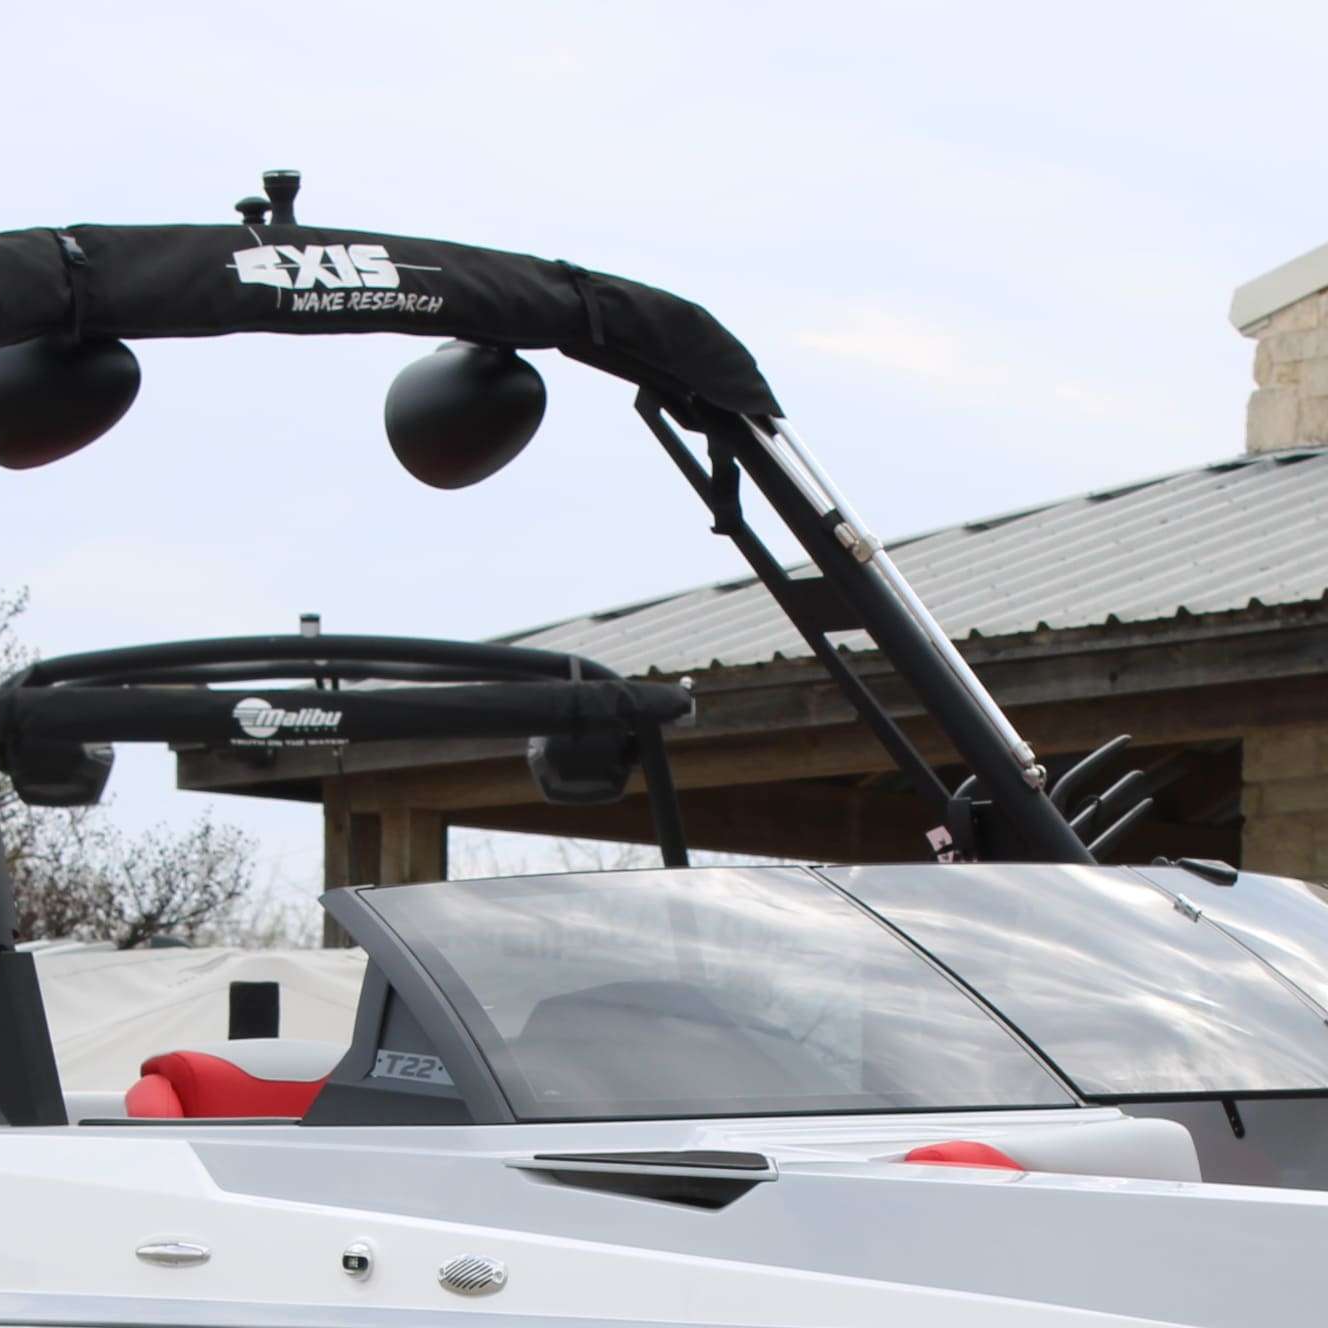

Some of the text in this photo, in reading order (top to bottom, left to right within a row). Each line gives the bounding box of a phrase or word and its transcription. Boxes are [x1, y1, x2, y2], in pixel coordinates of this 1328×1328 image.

[231, 243, 401, 290] AXIS
[290, 291, 444, 314] WAKE RESEARCH
[254, 706, 344, 727] Malibu
[385, 1053, 437, 1080] T22
